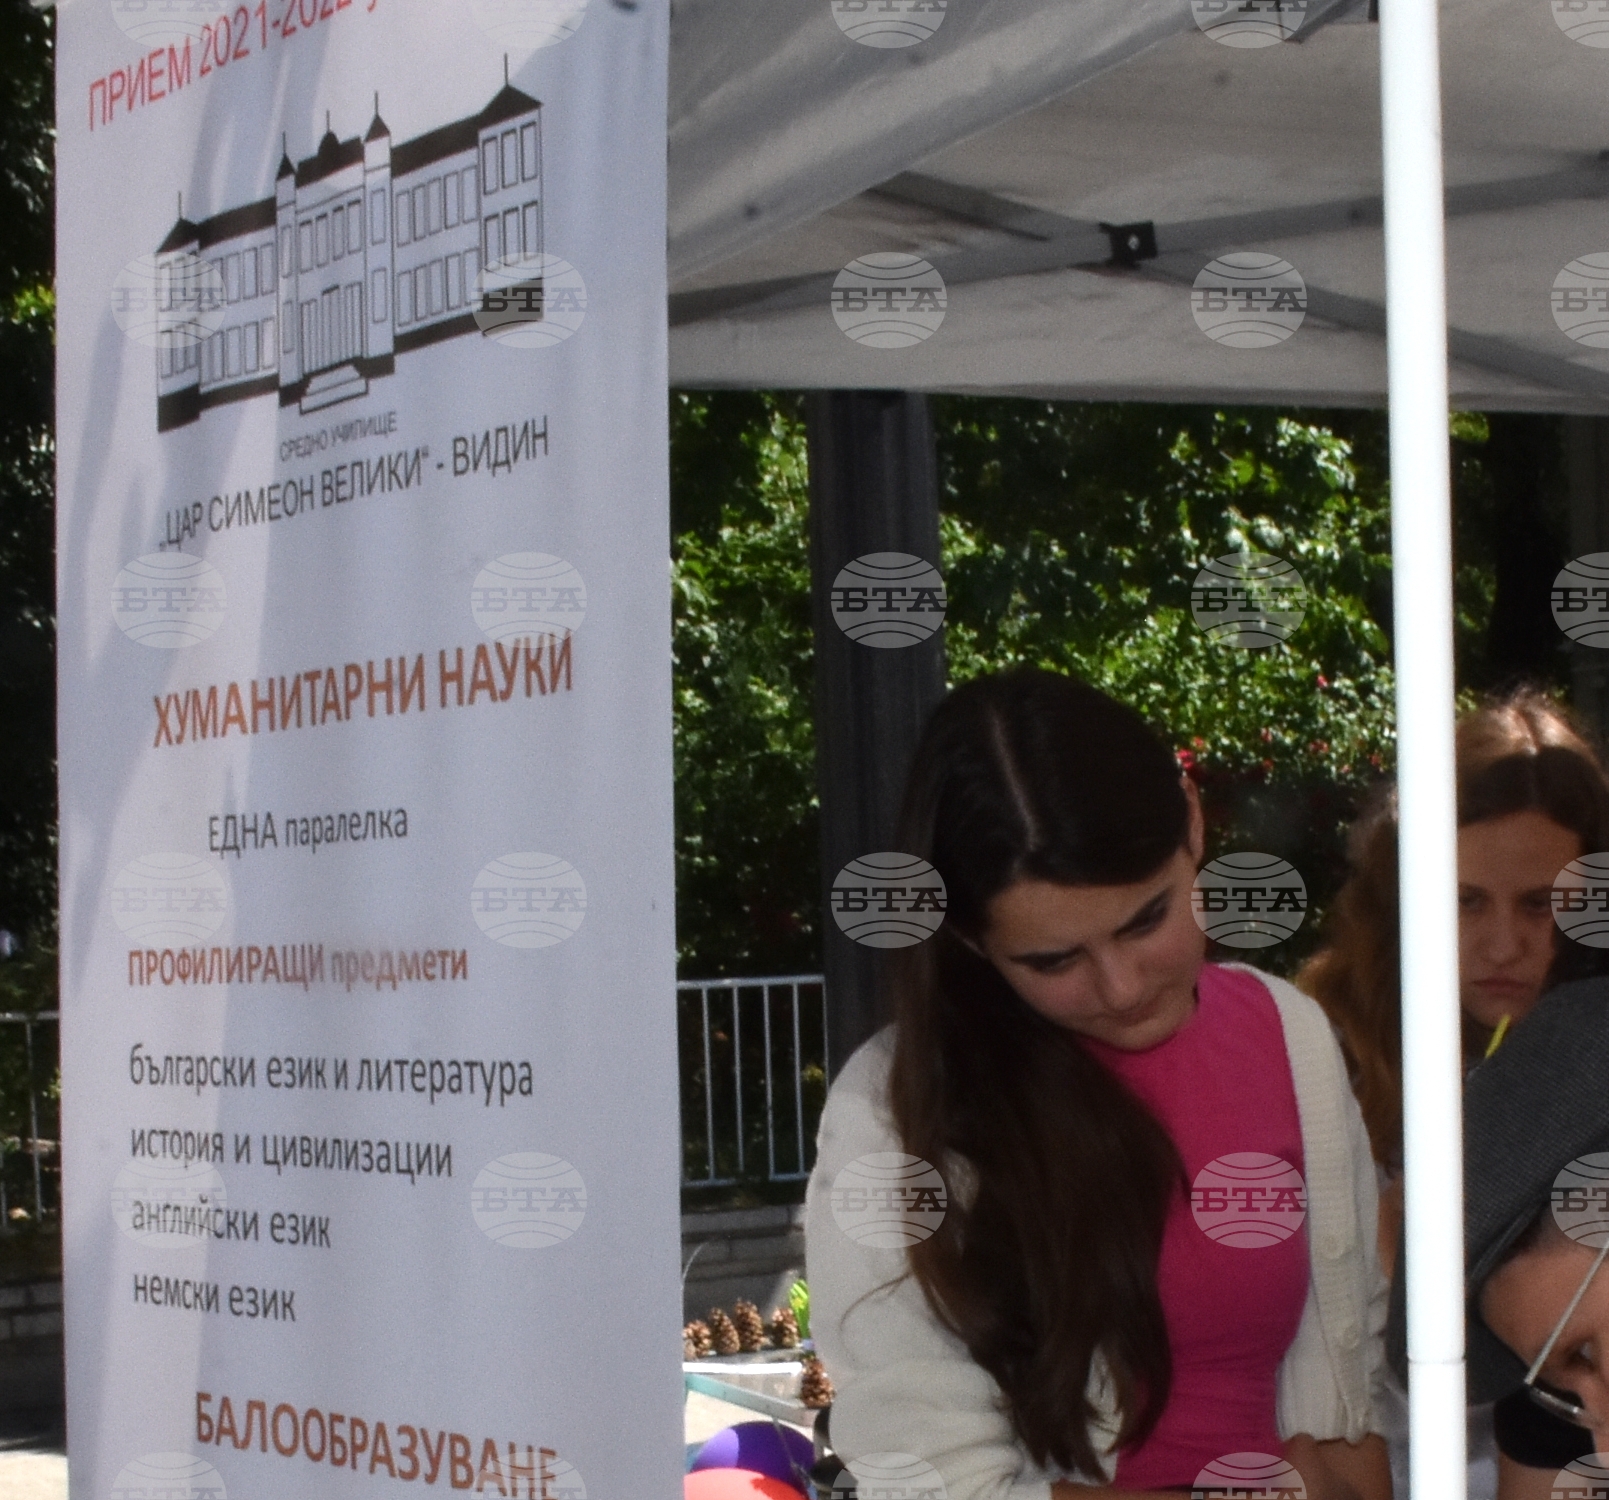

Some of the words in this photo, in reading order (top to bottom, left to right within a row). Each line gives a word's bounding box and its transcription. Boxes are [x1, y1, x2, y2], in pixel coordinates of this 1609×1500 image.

[88, 37, 192, 132] ПРИЕМ
[199, 0, 352, 77] 2021-20
[280, 430, 328, 463] СРЕДНО
[330, 411, 398, 449] УЧИЛИЩЕ
[208, 471, 316, 533] СИМЕОН
[453, 414, 549, 477] ВИДИН
[154, 652, 427, 748] ХУМАНИТАРНИ
[438, 629, 574, 708] НАУКИ
[207, 812, 278, 859] ЕДНА
[285, 806, 408, 854] паралелка
[128, 944, 326, 991] ПРОФИЛИРАЩИ
[331, 946, 469, 993] предмети
[129, 1043, 256, 1096] български
[266, 1053, 328, 1090] език
[333, 1057, 349, 1090] и
[355, 1055, 534, 1107] литература
[130, 1126, 224, 1168] история
[235, 1132, 252, 1164] и
[261, 1130, 454, 1187] цивилизации
[131, 1195, 260, 1242] английски
[270, 1206, 331, 1248] език
[133, 1270, 220, 1314] немски
[228, 1284, 297, 1322] език
